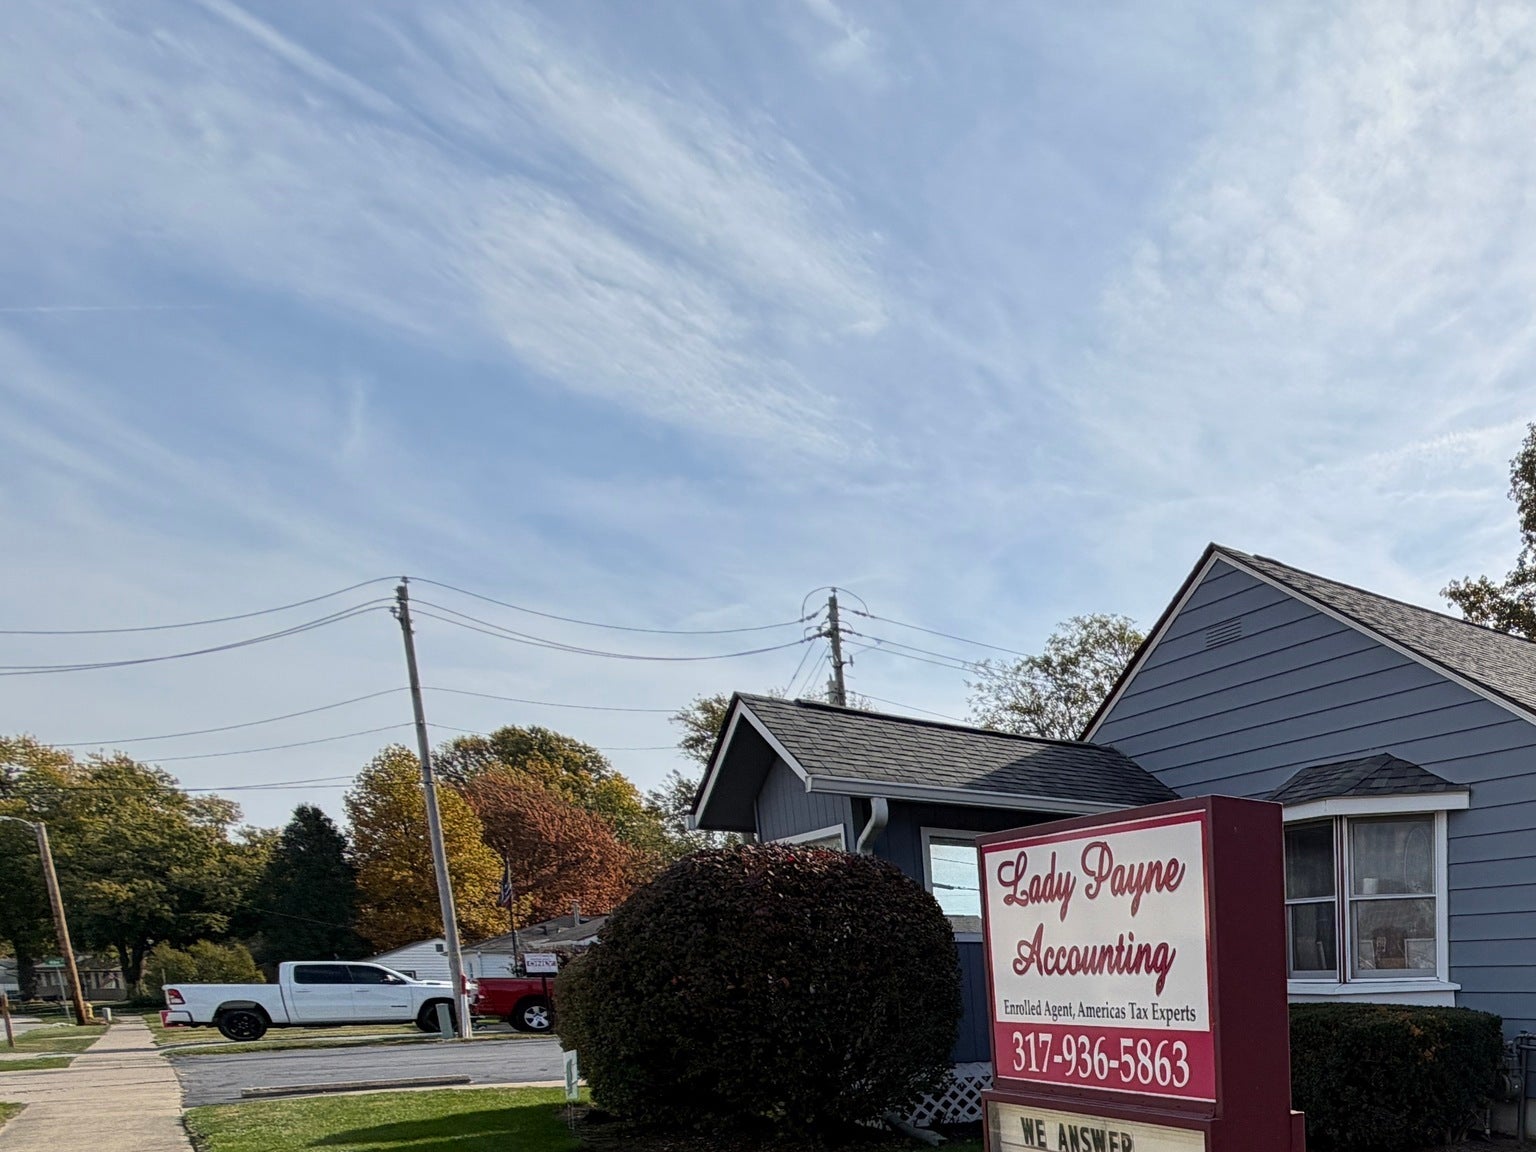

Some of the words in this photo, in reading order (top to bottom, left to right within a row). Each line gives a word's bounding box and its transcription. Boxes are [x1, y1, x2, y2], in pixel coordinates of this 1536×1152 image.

[997, 850, 1077, 922] Lady
[1080, 841, 1186, 917] Payne
[1012, 923, 1177, 996] Accounting
[1003, 999, 1042, 1016] Enrolled
[1044, 1001, 1077, 1022] Agent,
[1077, 1001, 1127, 1020] Americas
[1128, 1002, 1149, 1021] Tax
[1151, 1002, 1197, 1026] Experts
[1012, 1030, 1191, 1089] 317-936-5863
[1020, 1116, 1047, 1149] WE
